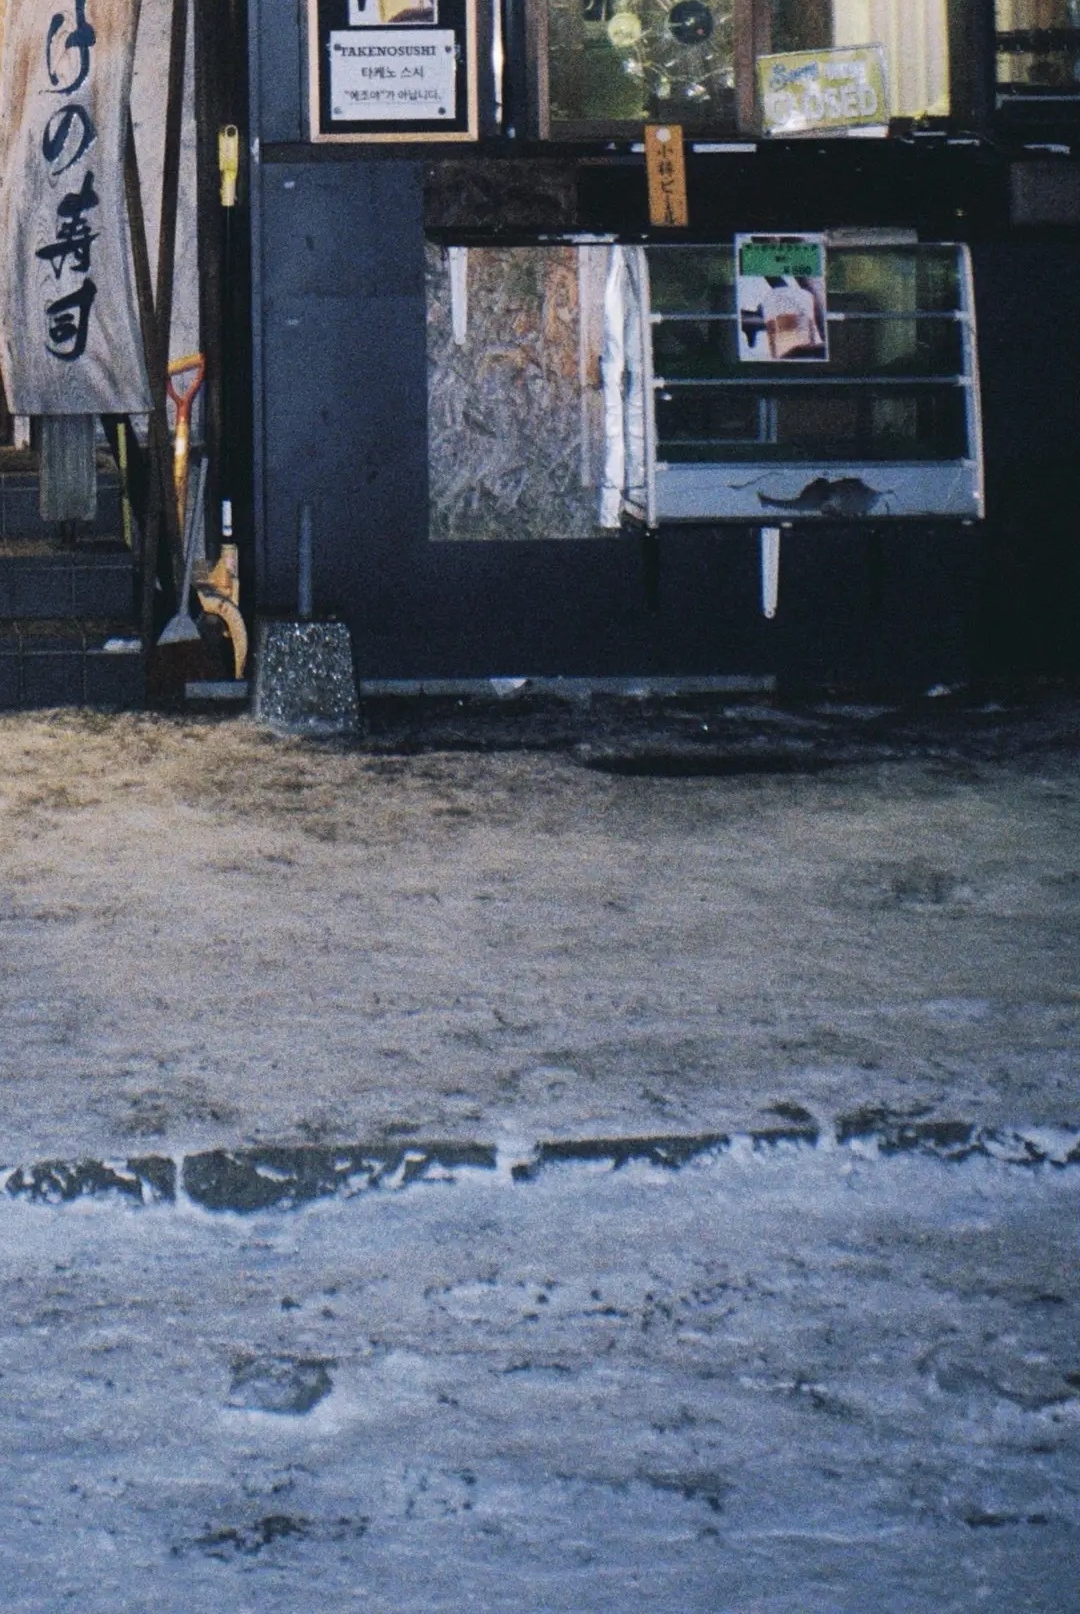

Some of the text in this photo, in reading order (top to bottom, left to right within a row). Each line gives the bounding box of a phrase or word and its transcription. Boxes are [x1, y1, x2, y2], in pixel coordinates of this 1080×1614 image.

[340, 45, 436, 57] TAKENOSUSHI
[361, 66, 424, 80] 타케노 스시
